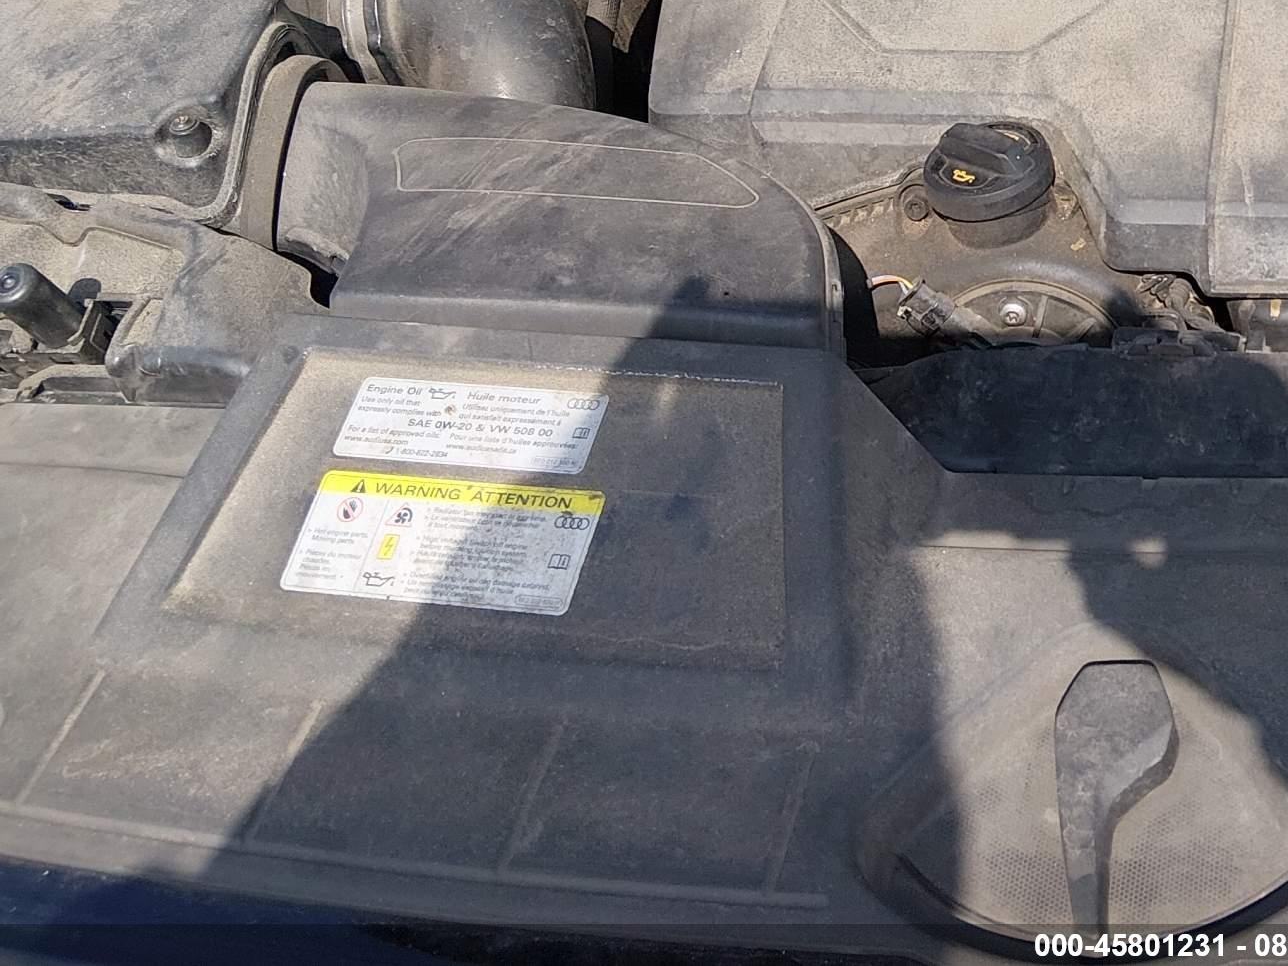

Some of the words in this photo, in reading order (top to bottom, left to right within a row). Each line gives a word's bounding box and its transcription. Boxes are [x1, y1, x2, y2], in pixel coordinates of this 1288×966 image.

[366, 384, 404, 396] Engine
[407, 386, 423, 396] Oil
[361, 395, 376, 403] Use
[378, 397, 393, 406] only
[395, 397, 405, 405] oil
[406, 398, 421, 406] that
[466, 391, 495, 402] Huile
[498, 394, 541, 404] moteur
[358, 405, 390, 416] expressly
[392, 407, 425, 417] complies
[425, 409, 441, 417] with
[490, 405, 535, 416] uniquement
[458, 412, 471, 421] qui
[472, 413, 501, 422] satisfait
[348, 425, 359, 433] For
[367, 426, 379, 434] list
[389, 429, 424, 438] approved
[408, 418, 432, 428] SAE
[434, 421, 472, 432] 0W-20
[475, 423, 485, 432] &
[490, 425, 510, 434] VW
[513, 426, 534, 436] 508
[537, 427, 554, 437] 00
[450, 432, 467, 441] Pour
[484, 435, 501, 443] liste
[374, 481, 463, 501] WARNING
[468, 488, 574, 510] ATTENTION
